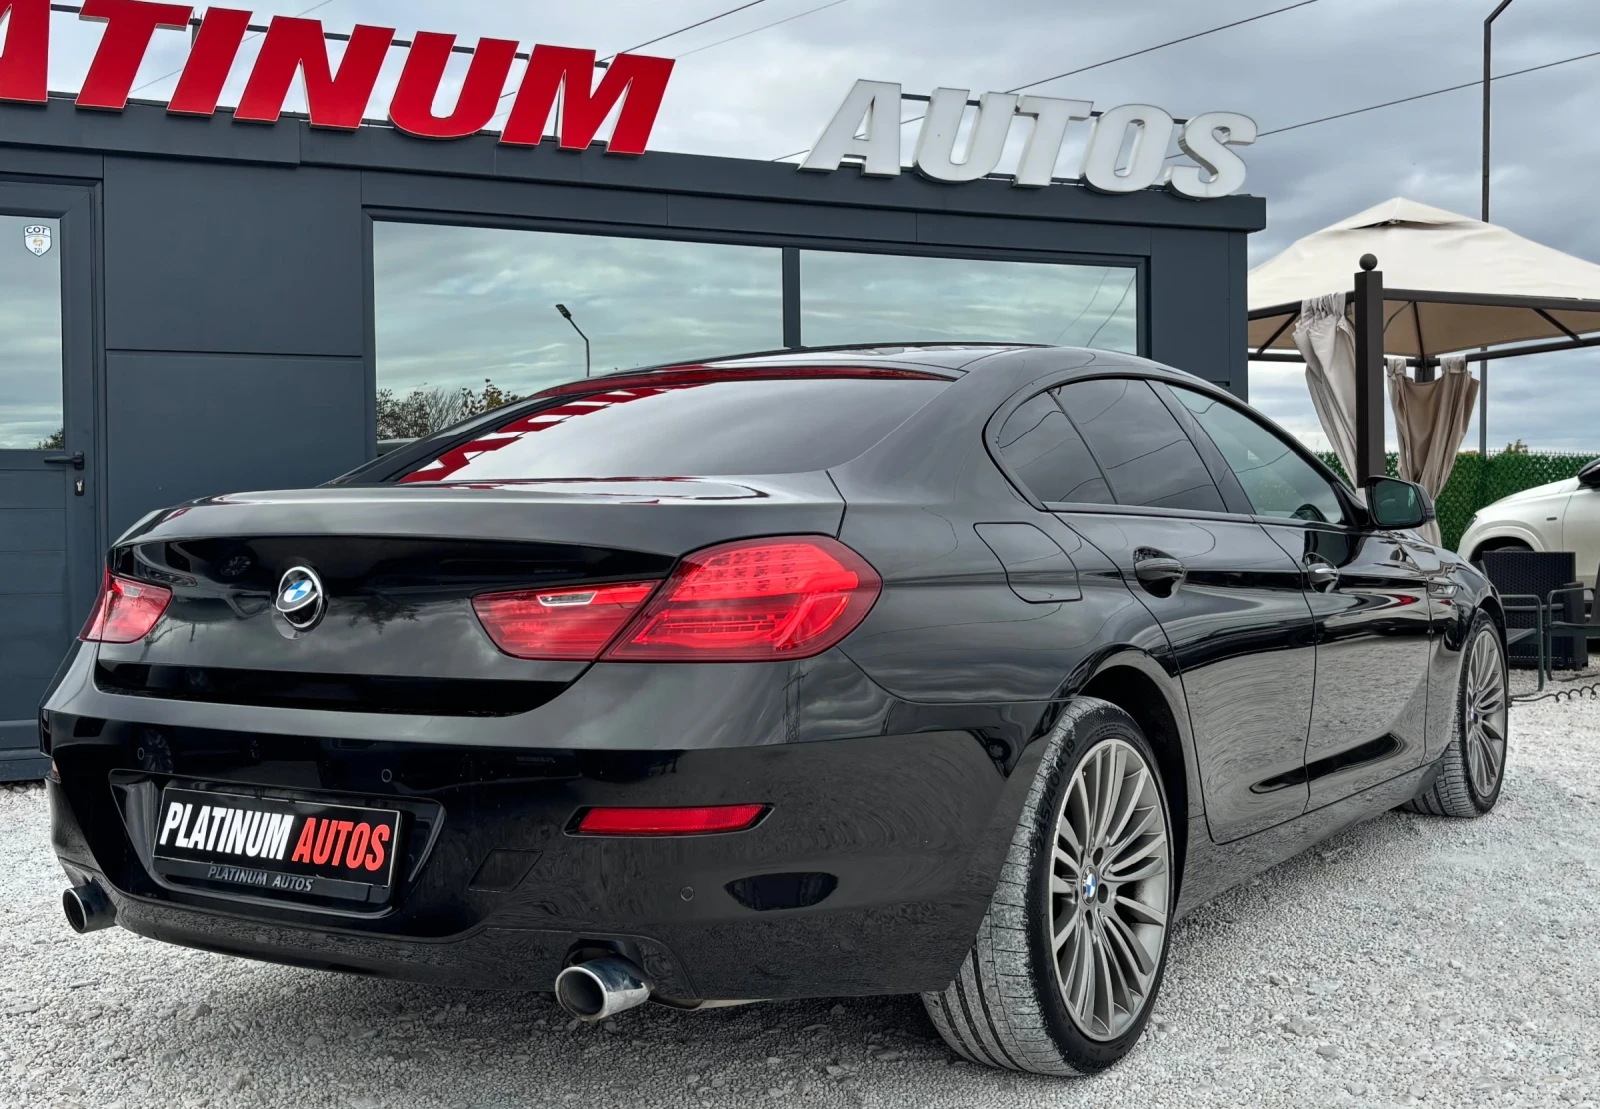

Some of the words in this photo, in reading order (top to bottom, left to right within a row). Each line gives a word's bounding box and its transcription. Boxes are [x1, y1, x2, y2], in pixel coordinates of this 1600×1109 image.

[798, 79, 1258, 199] AUTOS
[26, 226, 47, 234] COT
[159, 802, 294, 860] PLATINUM
[291, 817, 391, 872] AUTOS
[208, 866, 267, 886] PLATINUM
[272, 874, 314, 892] AUTOS
